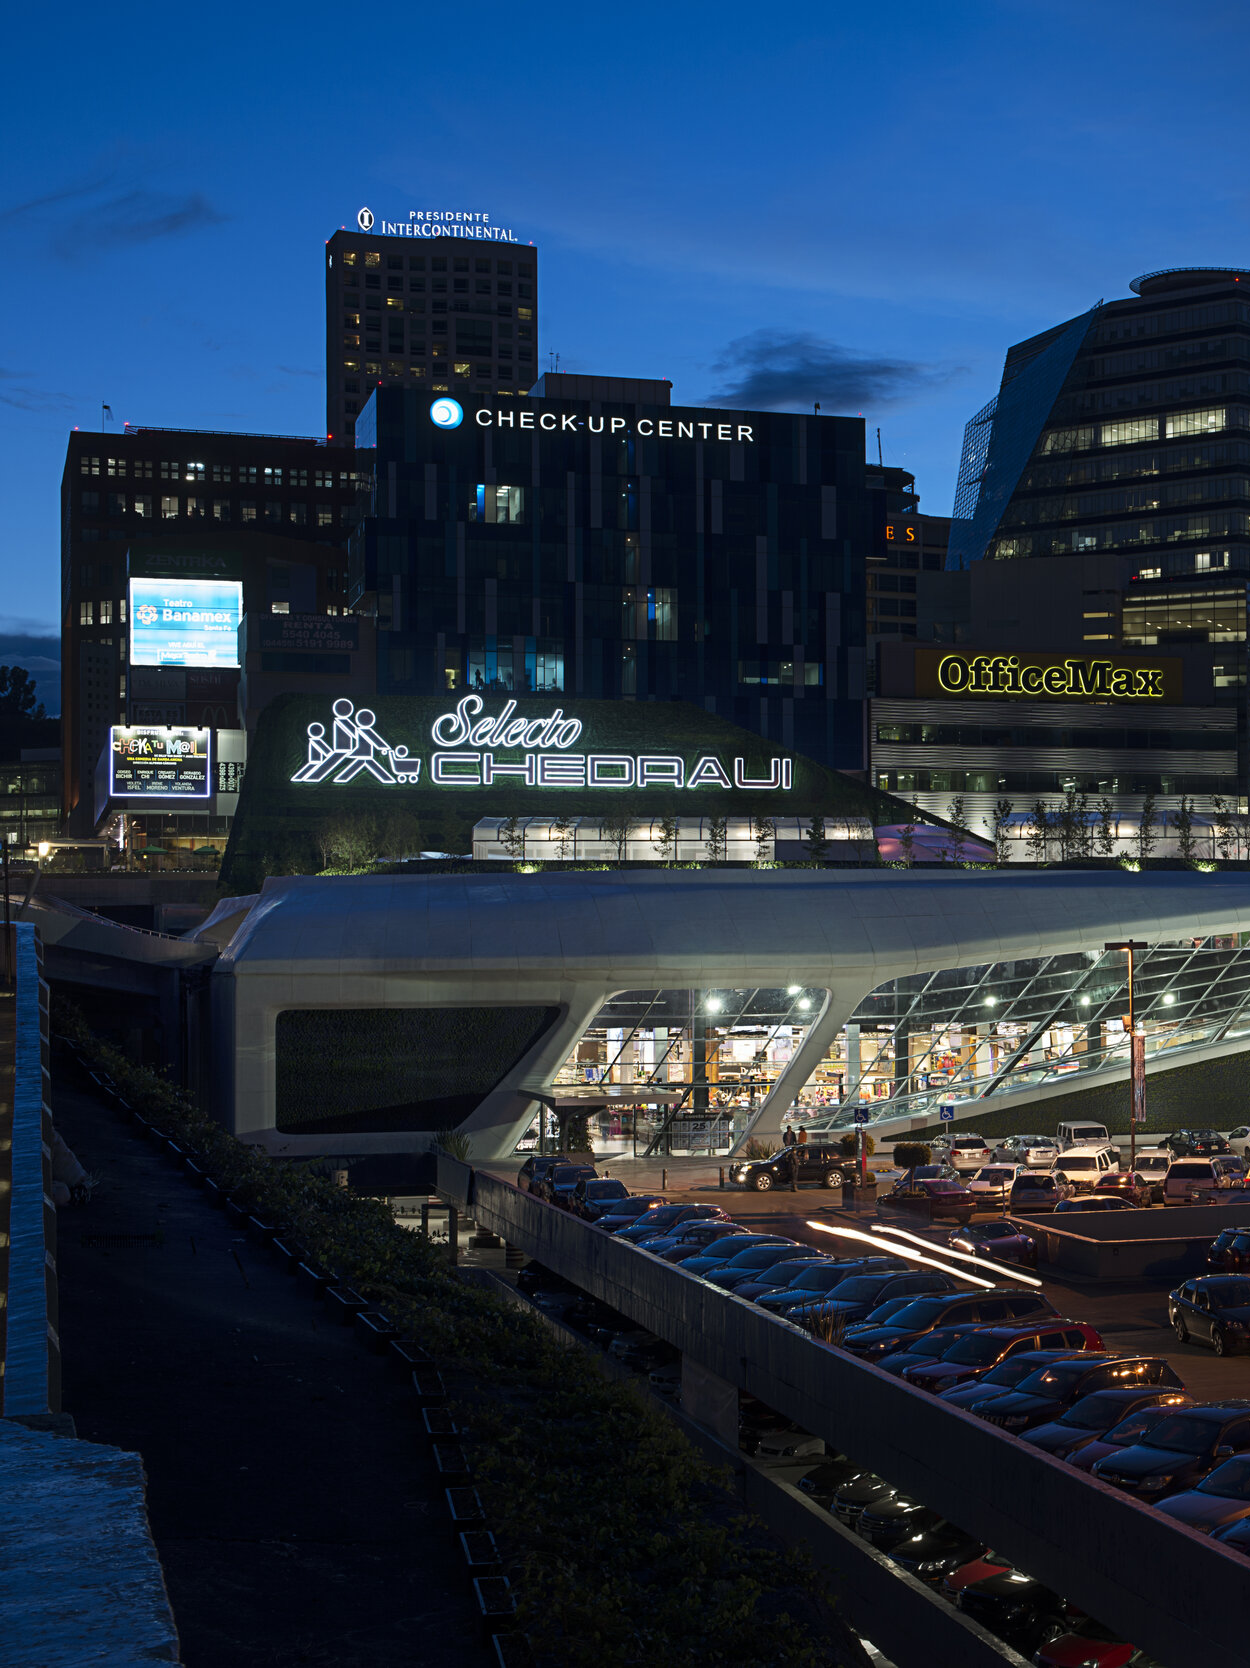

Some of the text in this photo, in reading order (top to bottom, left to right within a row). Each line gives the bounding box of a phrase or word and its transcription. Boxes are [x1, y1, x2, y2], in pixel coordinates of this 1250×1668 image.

[409, 211, 489, 223] PRESIDENTE
[475, 409, 755, 443] CHECK-UP CENTER
[163, 599, 193, 608] Teatro
[162, 609, 232, 623] Banamex
[283, 621, 334, 630] RENTA
[938, 654, 1164, 698] OfficeMax
[431, 694, 583, 749] Selecto
[430, 751, 794, 791] CHEDRAUI
